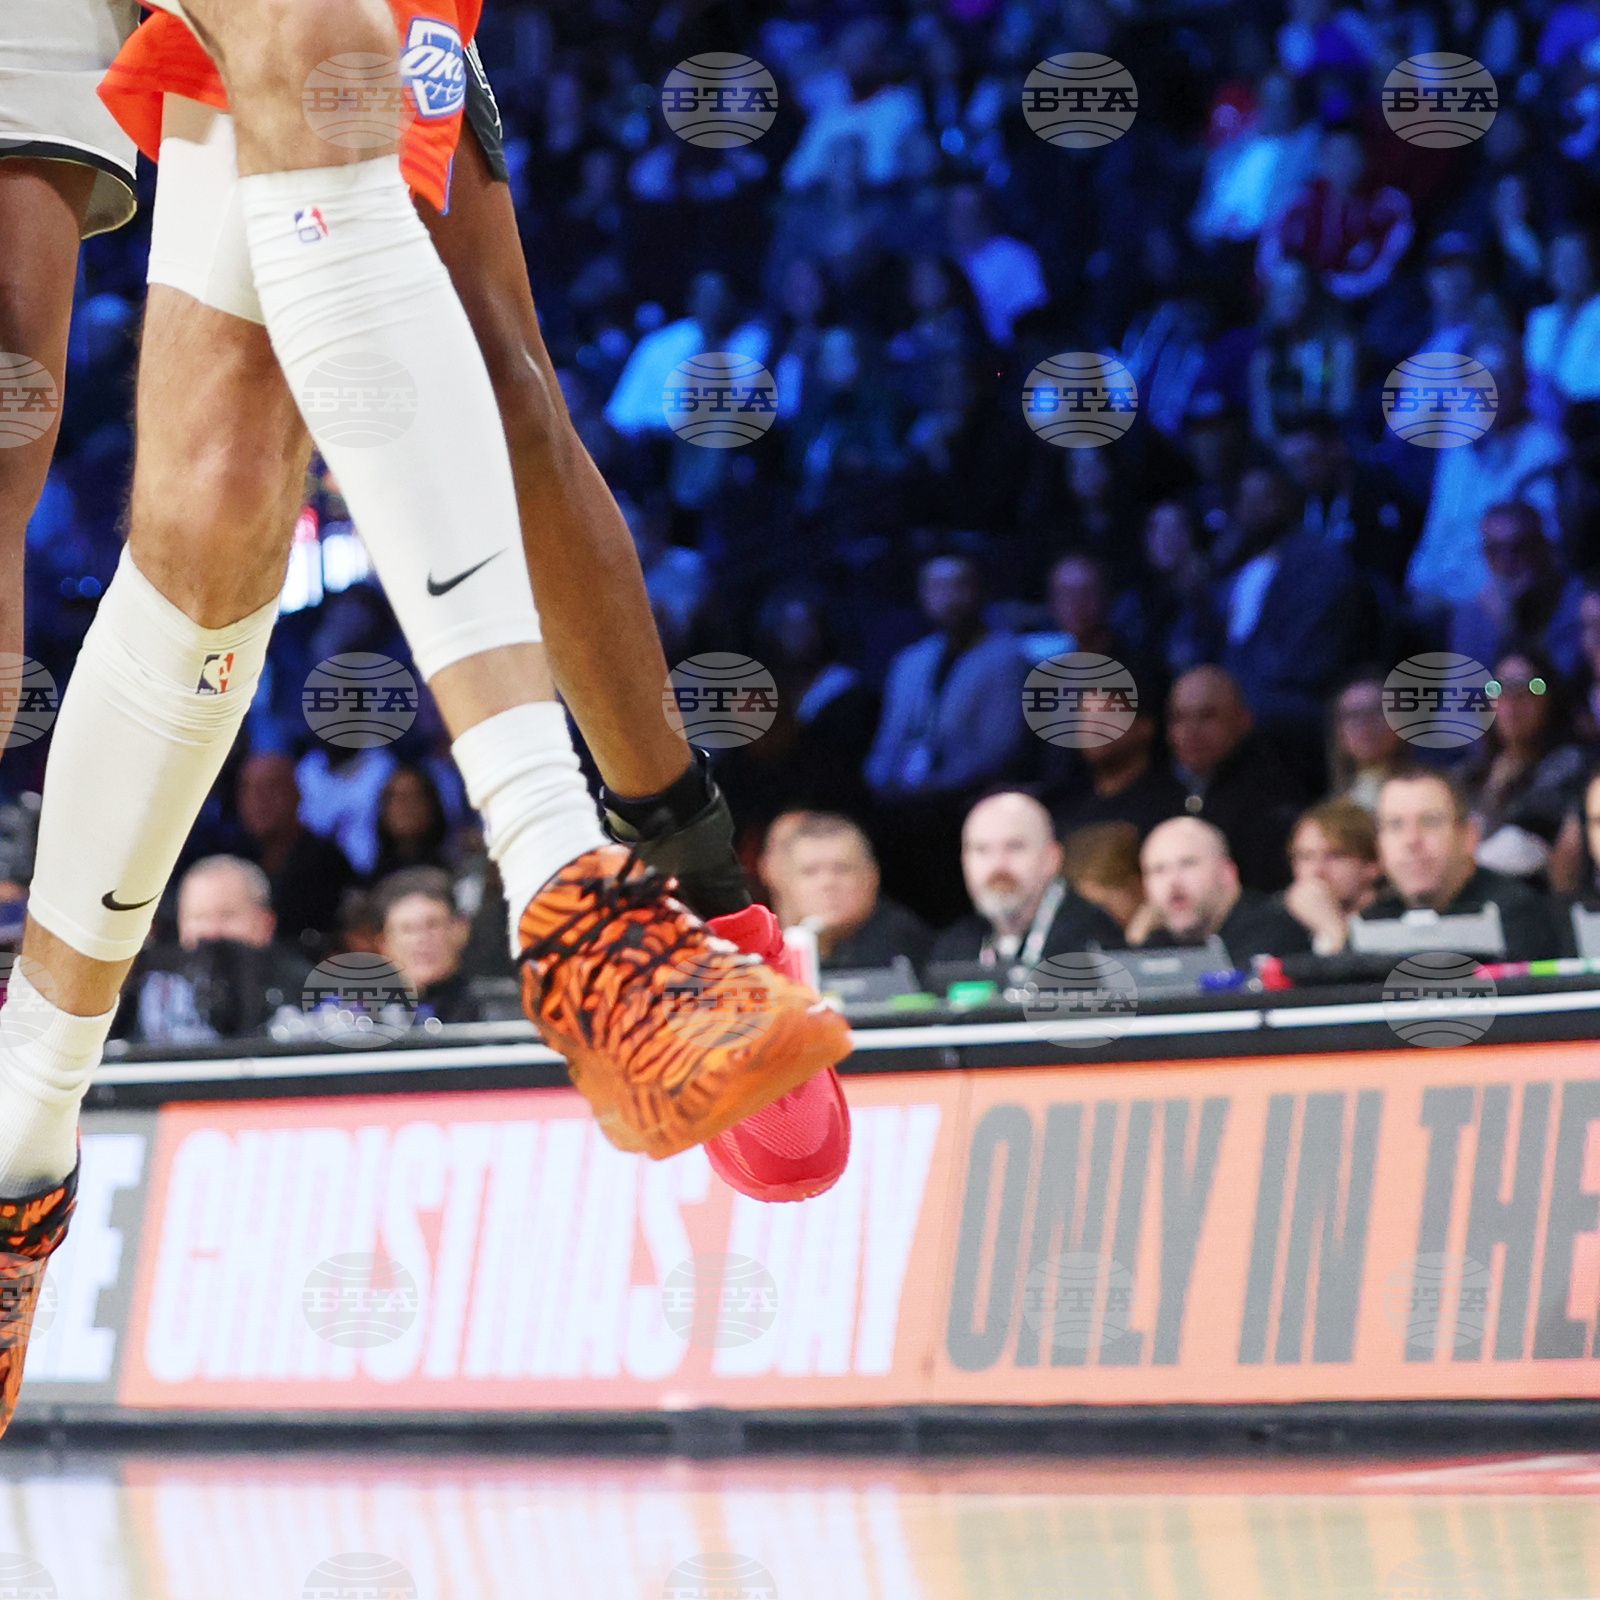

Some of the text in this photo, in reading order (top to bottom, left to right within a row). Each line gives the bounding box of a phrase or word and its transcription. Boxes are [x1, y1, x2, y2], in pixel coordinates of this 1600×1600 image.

[145, 1104, 943, 1383] CHRISTMAS DAY
[945, 1079, 1600, 1372] ONLY IN THE
